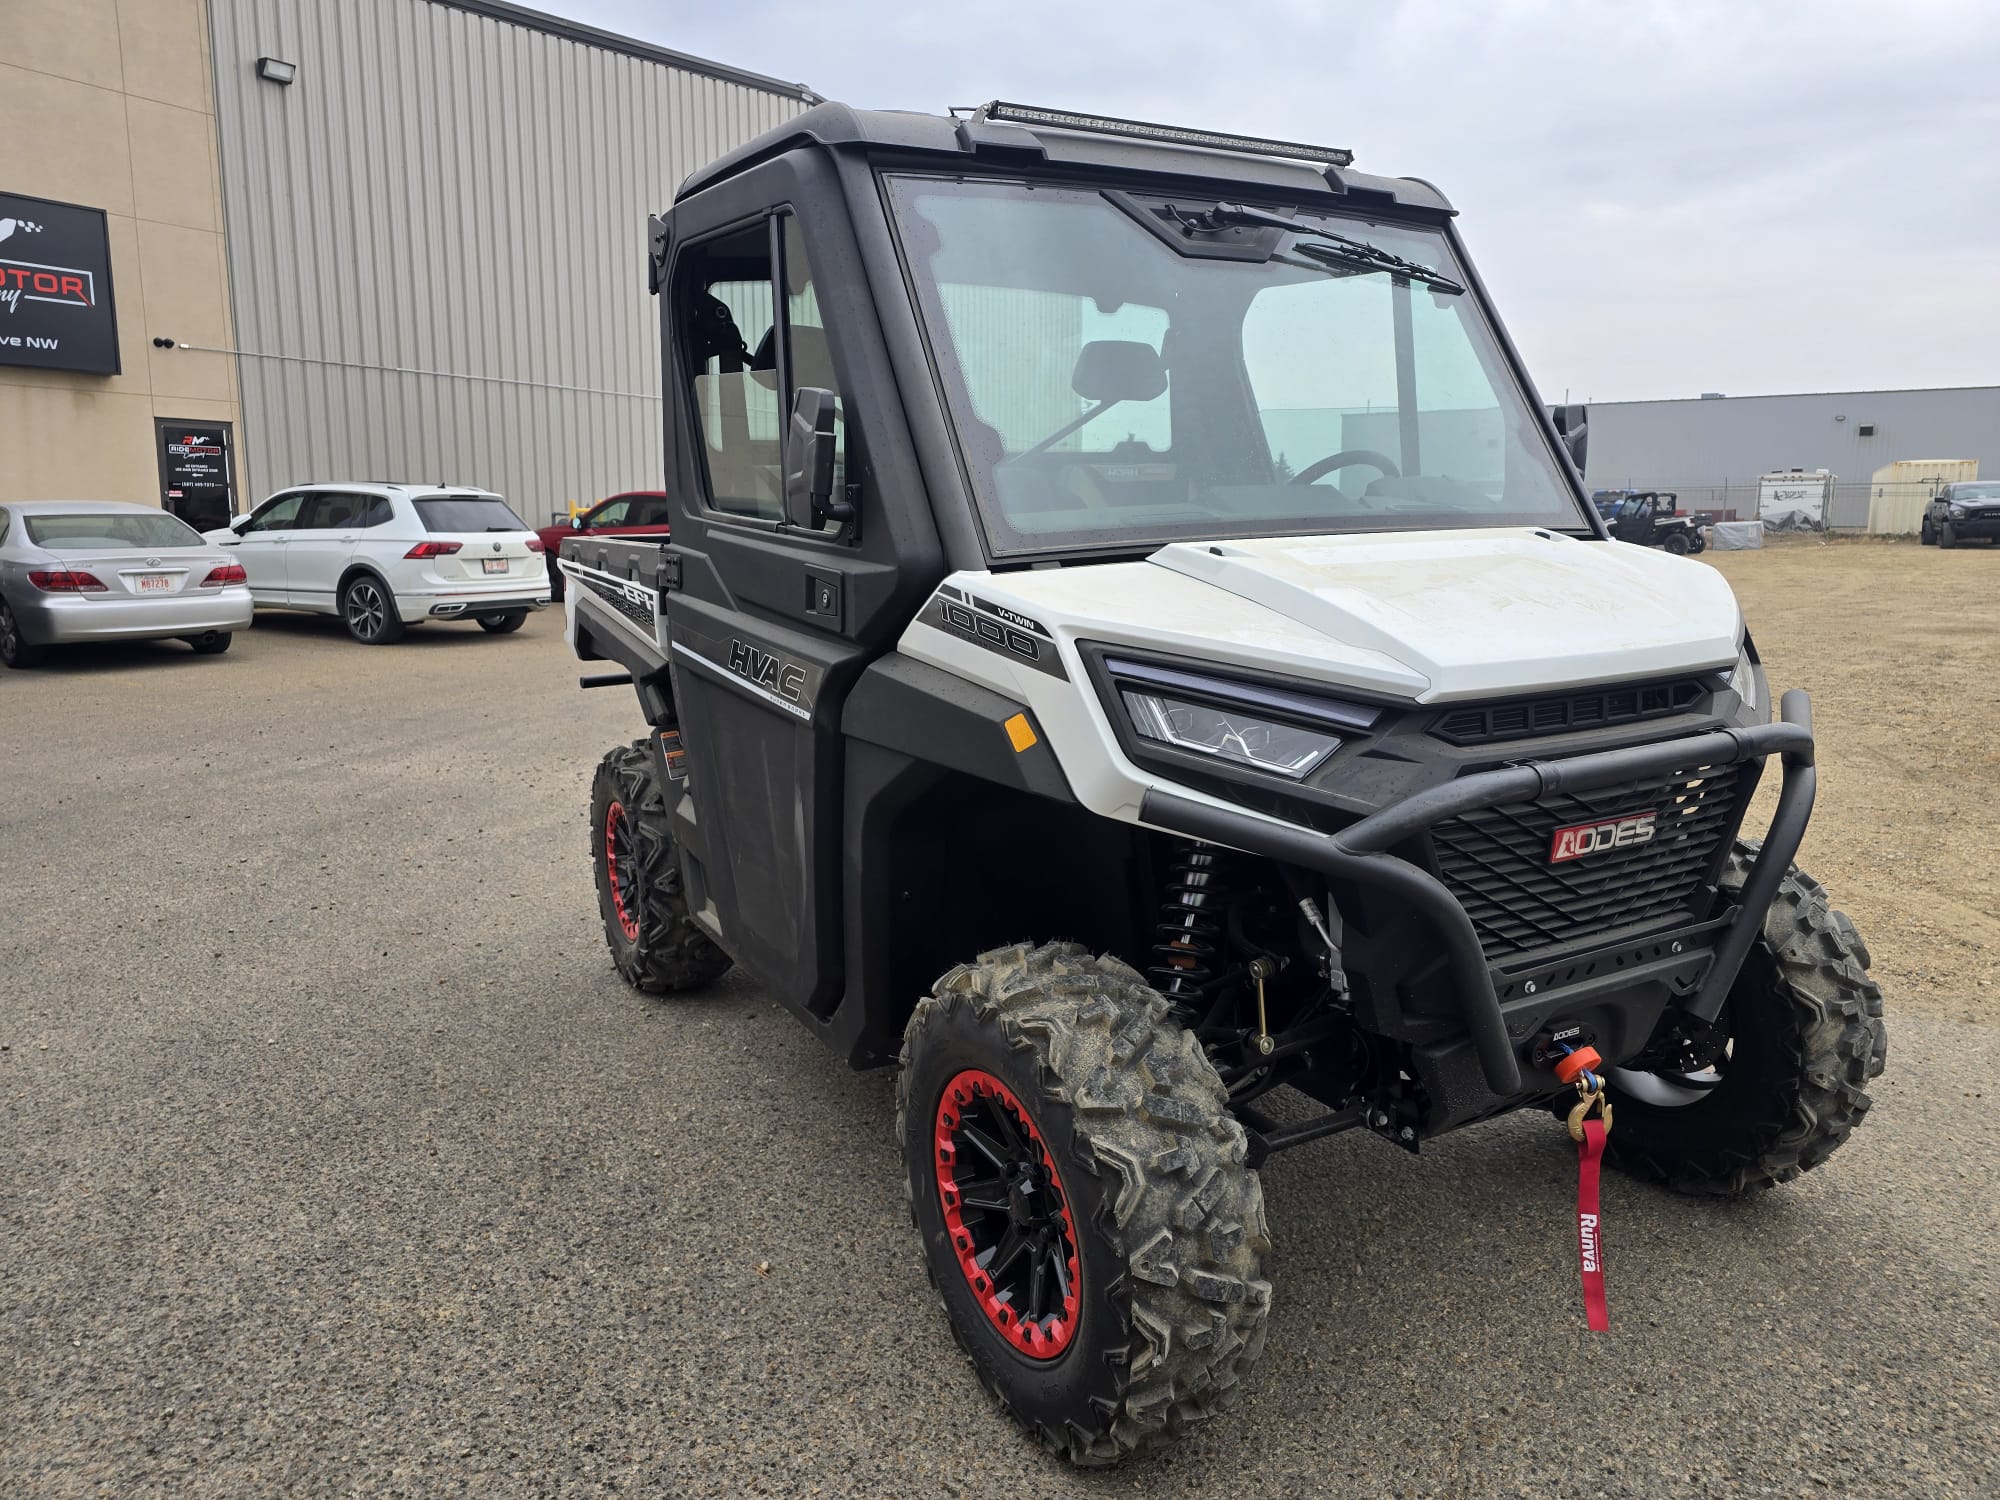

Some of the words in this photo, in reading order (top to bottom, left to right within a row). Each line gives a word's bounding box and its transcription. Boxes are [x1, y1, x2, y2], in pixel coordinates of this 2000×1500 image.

[0, 267, 94, 308] TOR
[26, 336, 58, 350] NW
[938, 599, 1040, 661] 1000
[997, 607, 1035, 630] V-TWIN
[728, 639, 807, 702] HVAC
[1555, 816, 1656, 859] AODES
[1580, 1213, 1598, 1272] Runva
